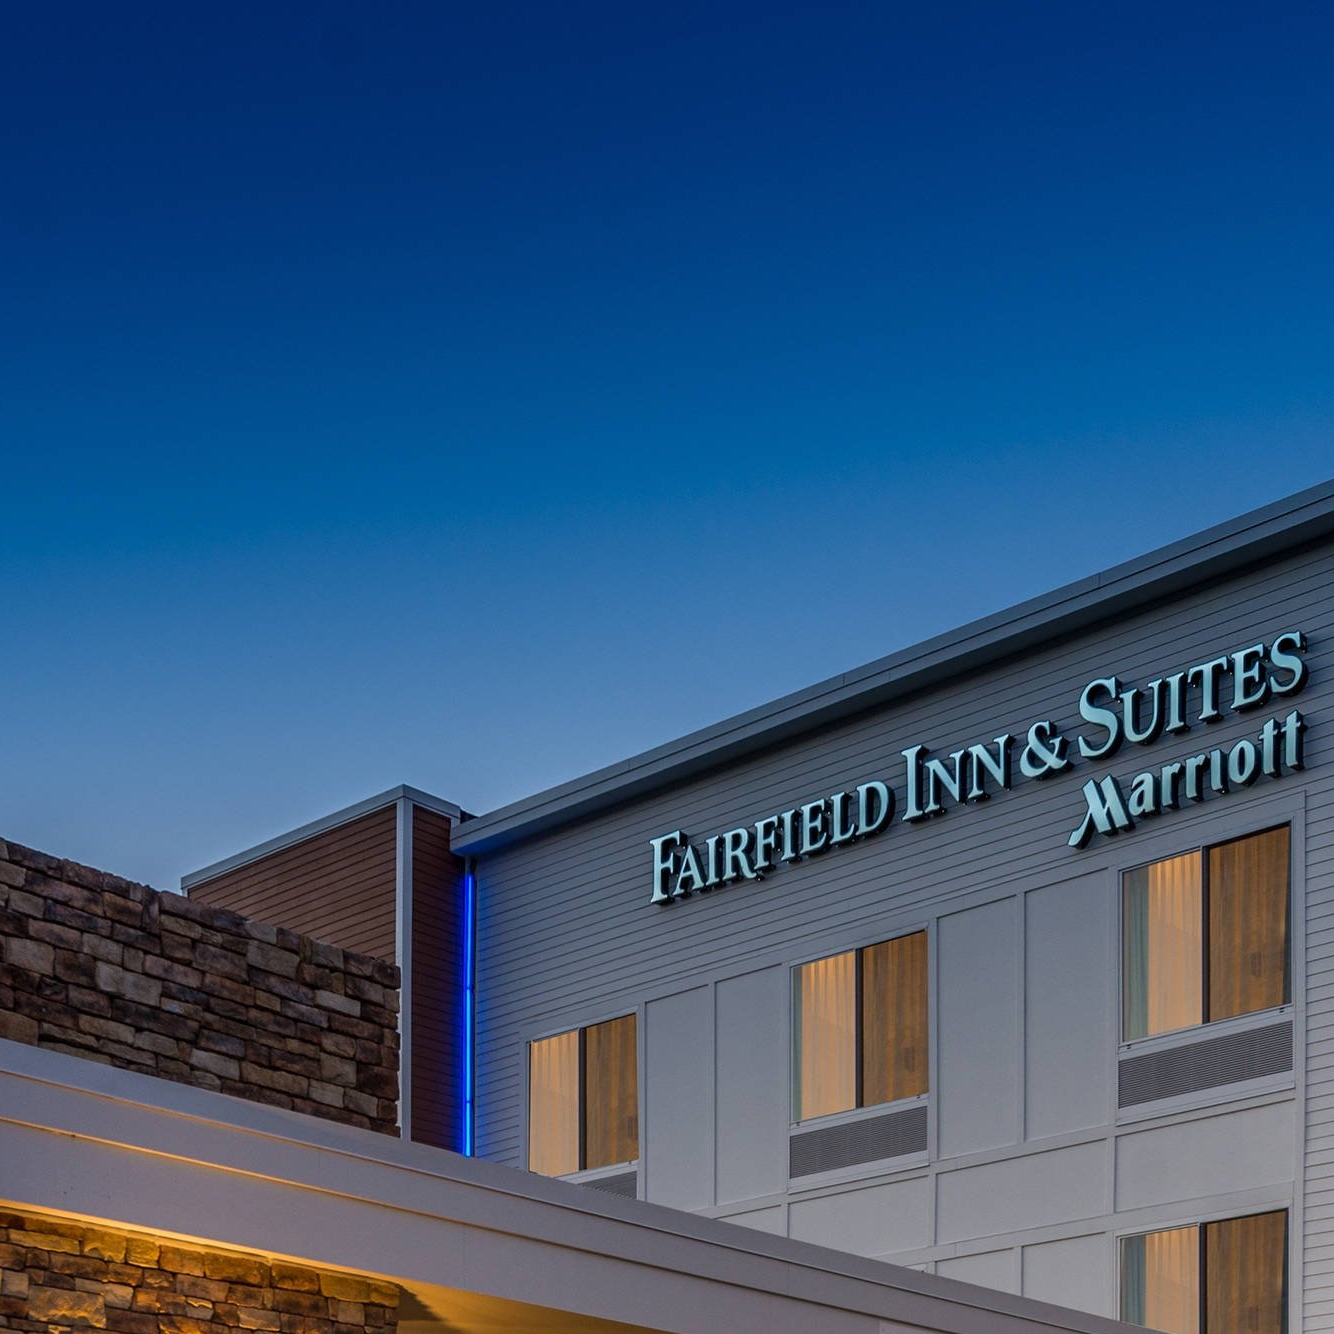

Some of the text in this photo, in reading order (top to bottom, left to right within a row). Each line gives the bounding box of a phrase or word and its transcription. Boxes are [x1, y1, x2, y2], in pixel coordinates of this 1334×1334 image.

[649, 630, 1309, 904] FAIRFIELD INN & SUITES
[1067, 709, 1307, 849] Marriott
